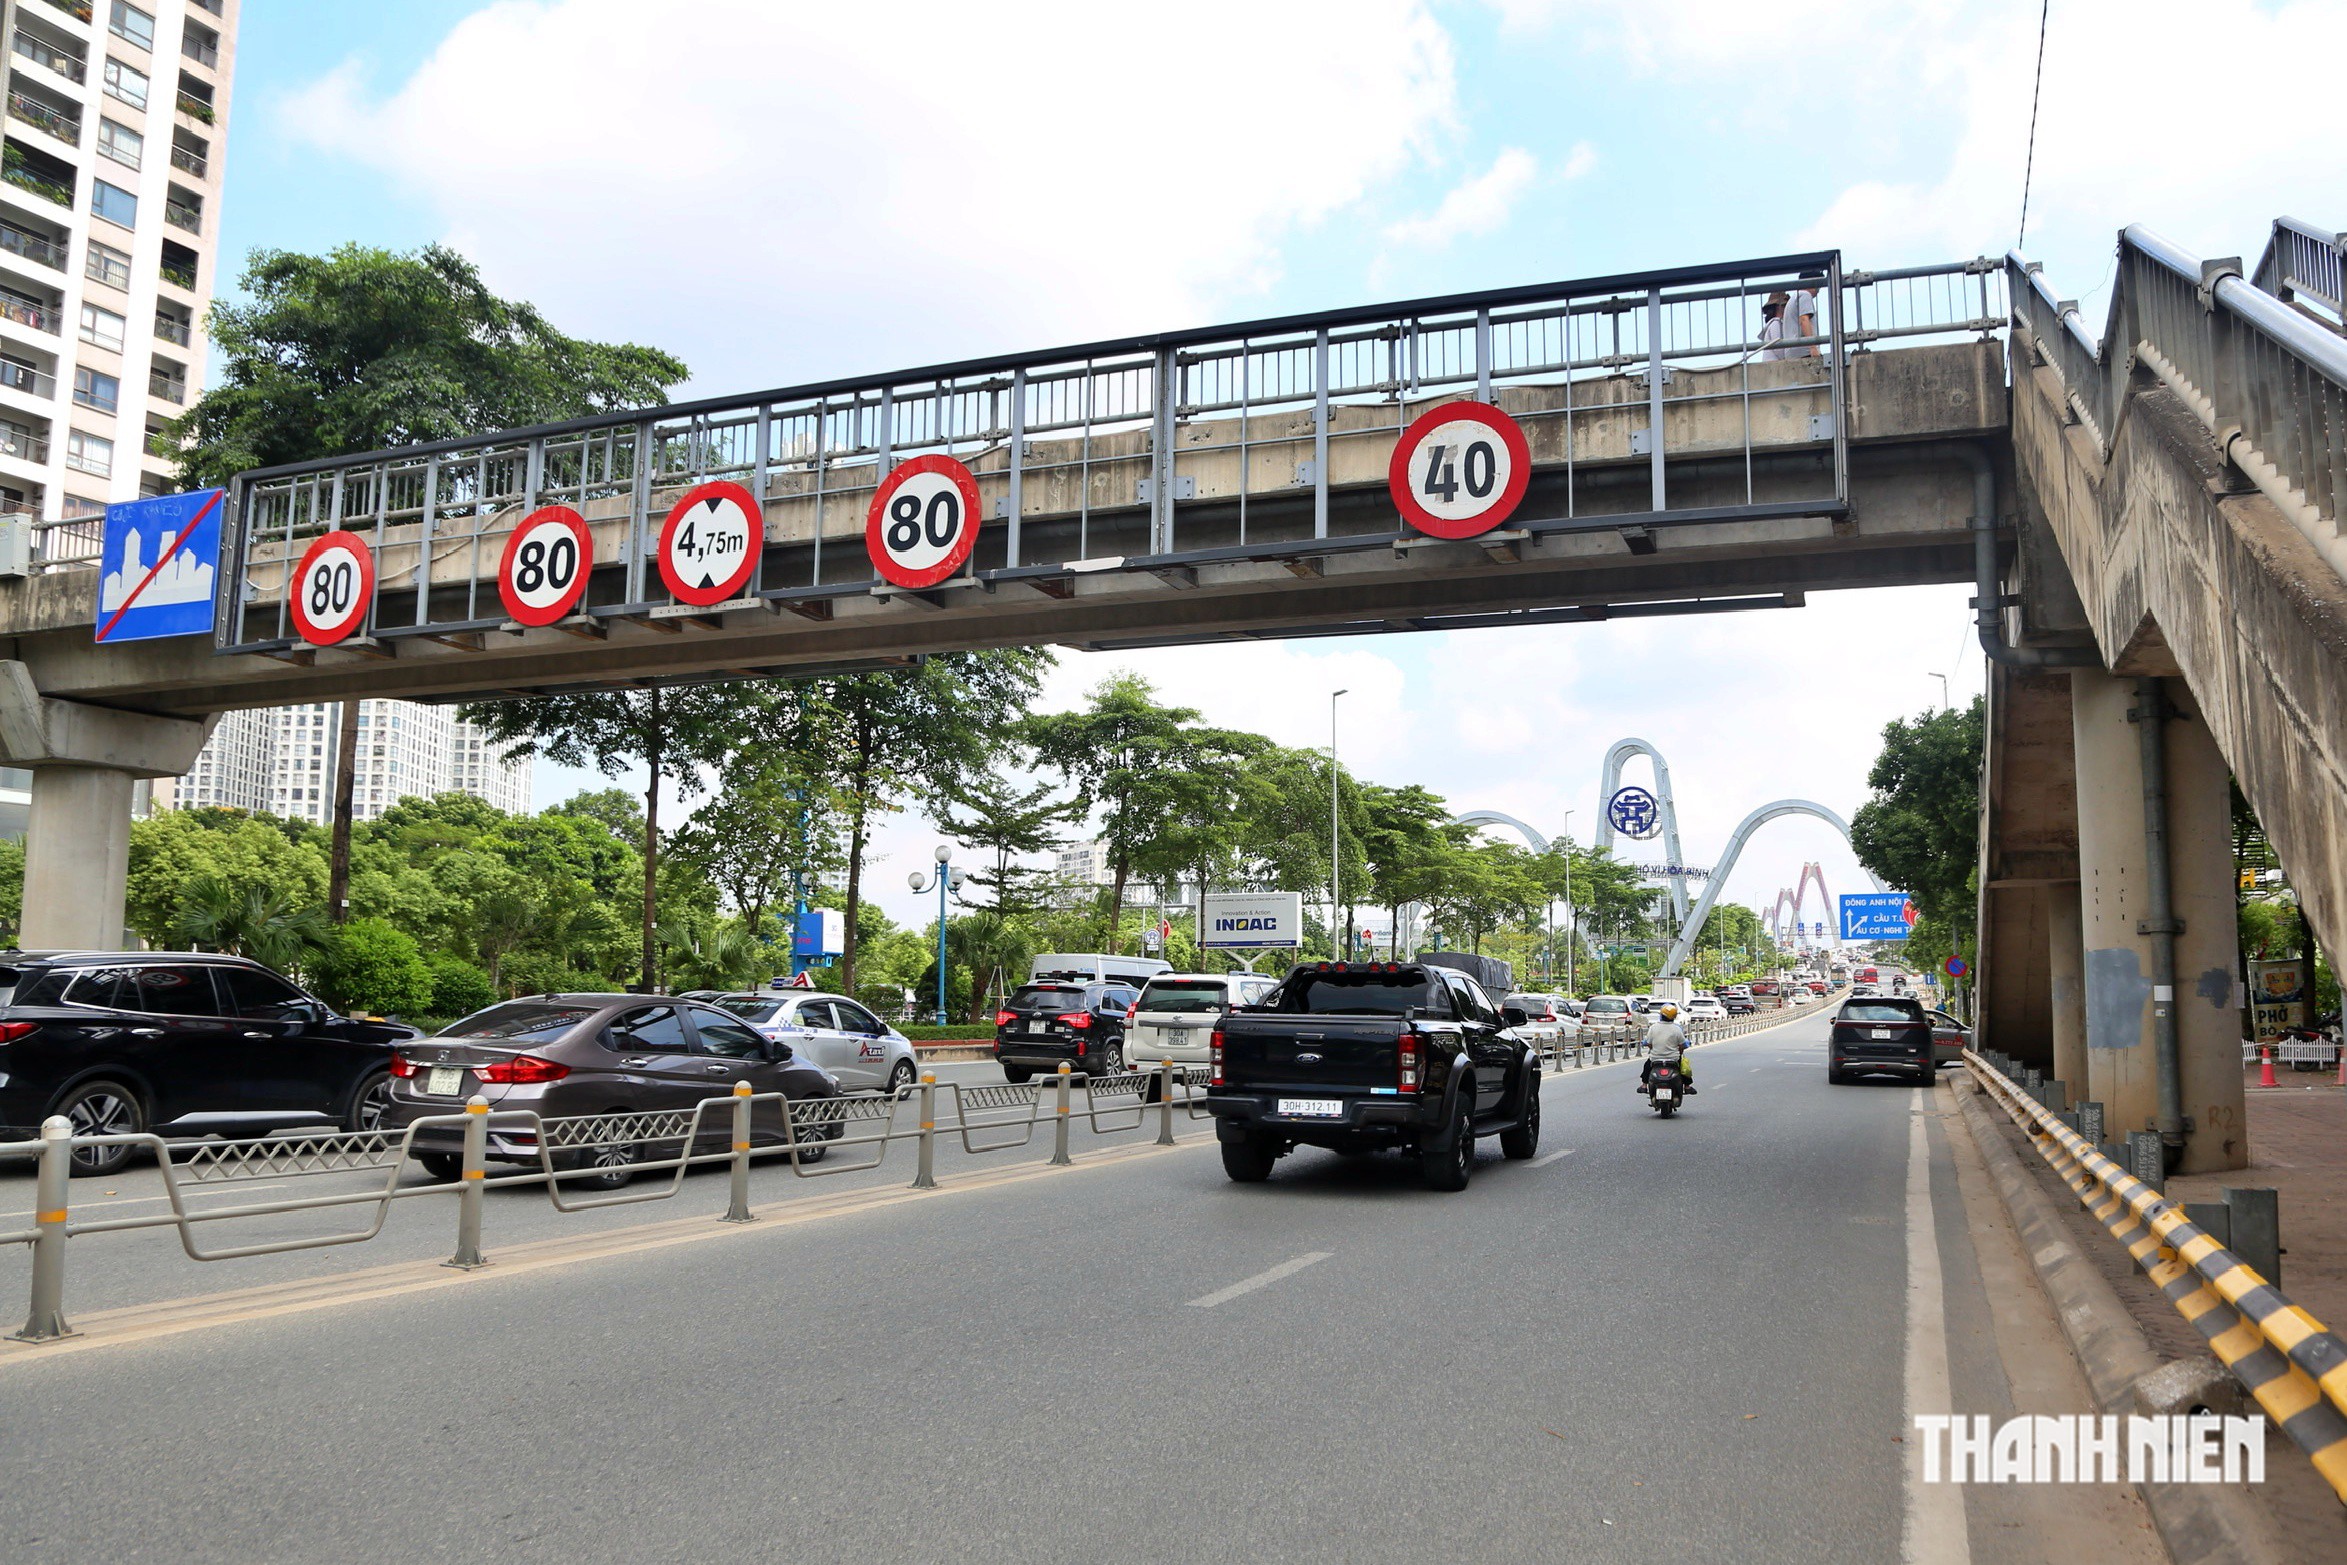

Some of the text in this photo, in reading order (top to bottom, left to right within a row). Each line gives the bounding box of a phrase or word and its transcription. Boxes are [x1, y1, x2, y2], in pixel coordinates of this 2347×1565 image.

[1424, 440, 1498, 502] 40
[887, 490, 959, 551] 80
[677, 522, 743, 563] 4,75m
[516, 537, 576, 593] 80
[311, 562, 352, 615] 80
[1845, 897, 1867, 907] ĐÔNG
[1869, 899, 1886, 907] ANH
[1888, 897, 1902, 907] NỘI
[1216, 917, 1277, 931] INOAC
[1873, 912, 1890, 922] CẦU
[792, 972, 809, 988] A
[2258, 1004, 2288, 1023] PHỞ
[2260, 1025, 2277, 1036] BÒ
[1283, 1101, 1337, 1111] 30H-312.11
[2148, 1154, 2157, 1164] XE
